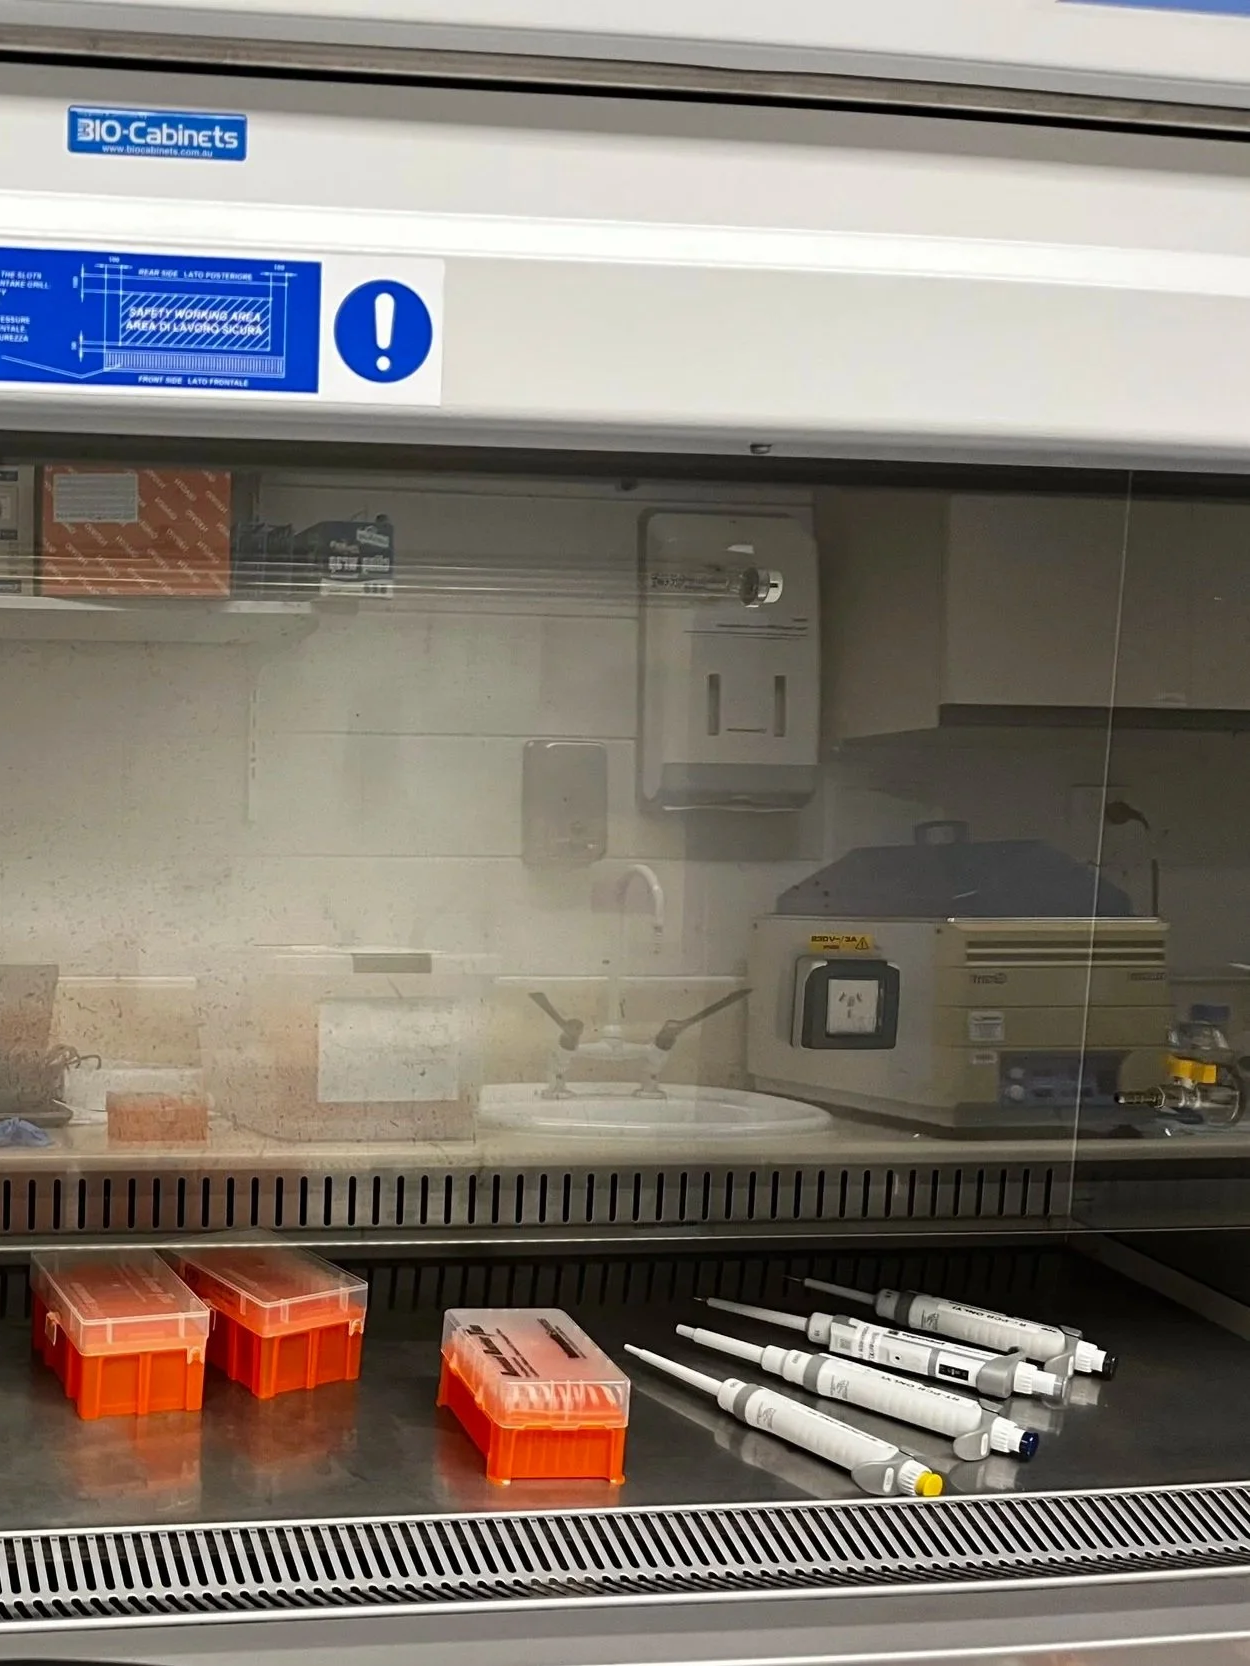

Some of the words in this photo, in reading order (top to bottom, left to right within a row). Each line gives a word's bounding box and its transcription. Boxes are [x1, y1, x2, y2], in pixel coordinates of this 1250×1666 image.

[77, 118, 238, 149] BIO-Cabinets
[102, 144, 213, 157] www.biocabinets.com.au
[1, 270, 15, 279] THE
[138, 268, 160, 277] REAR
[162, 269, 179, 278] SIDE
[183, 271, 204, 280] LATO
[205, 272, 253, 281] POSTERIORE
[129, 307, 173, 319] SAFETY
[174, 309, 228, 321] WORKING
[230, 311, 262, 322] AREA
[126, 322, 156, 332] AREA
[159, 323, 172, 332] DI
[173, 324, 219, 335] LAVORO
[222, 325, 263, 336] SICURA
[138, 375, 164, 384] FRONT
[165, 377, 183, 385] SIDE
[187, 378, 208, 386] LATO
[209, 378, 249, 387] FRONTALE
